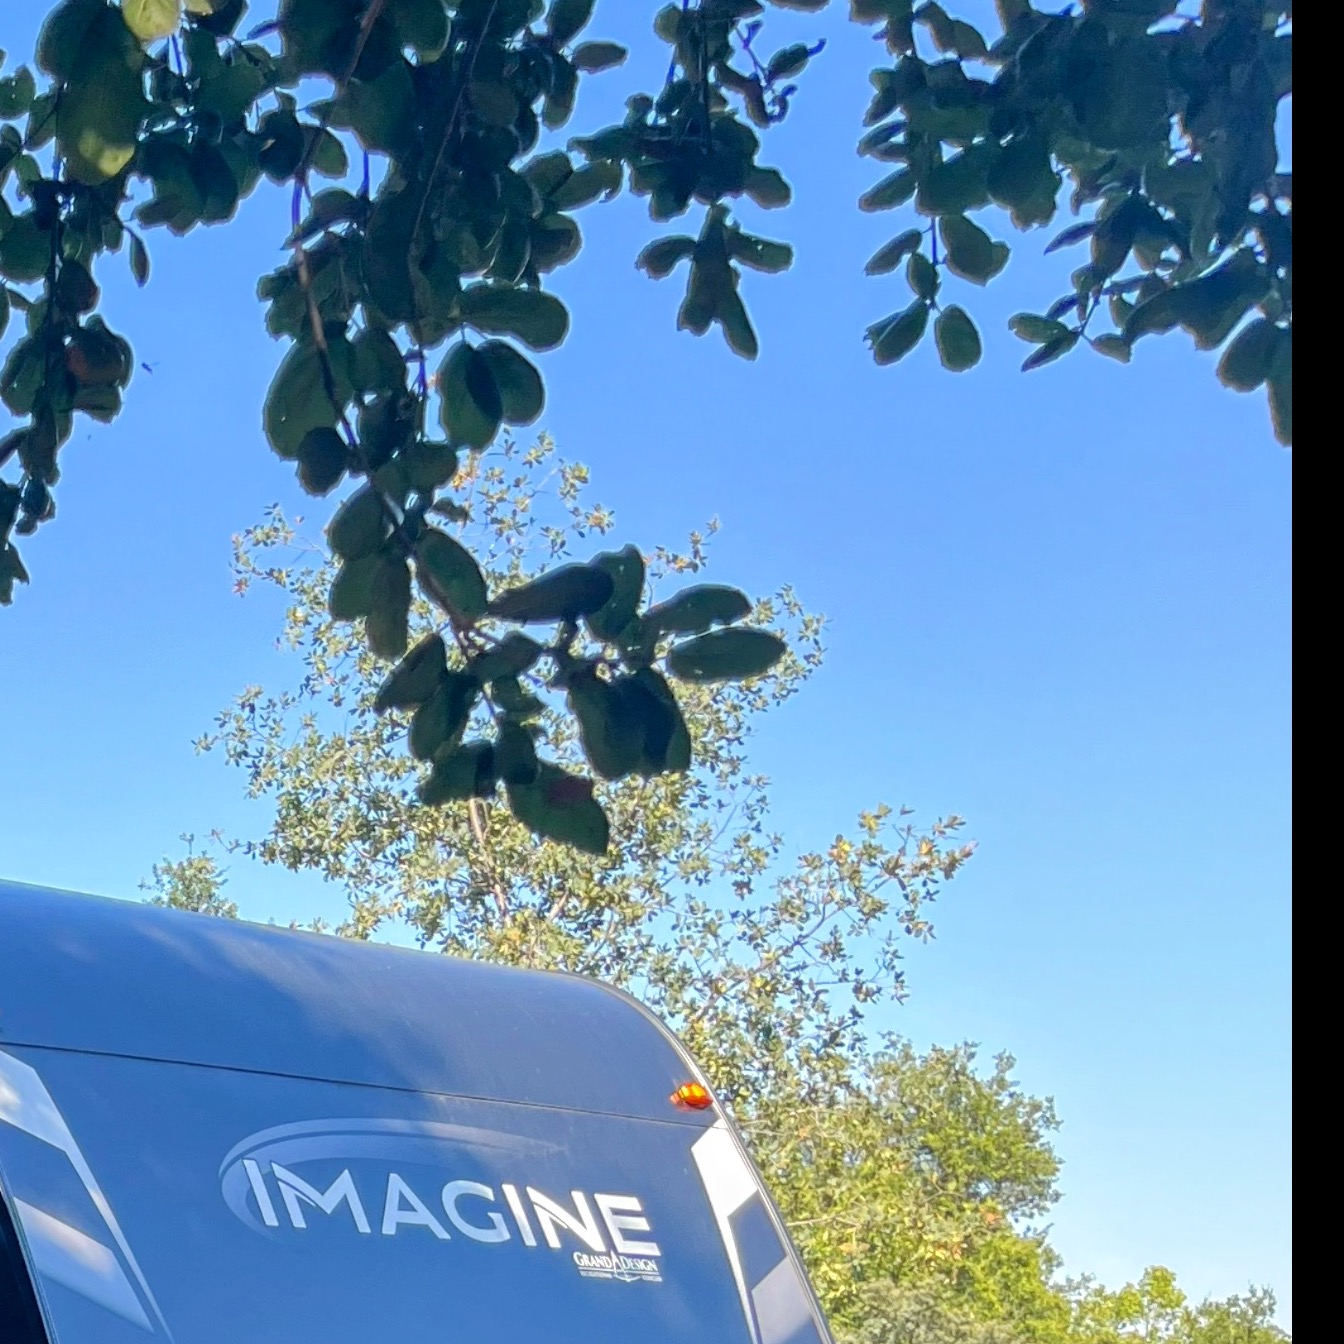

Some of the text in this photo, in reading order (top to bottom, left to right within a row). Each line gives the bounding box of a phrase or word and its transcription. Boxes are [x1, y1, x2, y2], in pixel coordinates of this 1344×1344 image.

[243, 1159, 660, 1256] IMAGINE
[573, 1252, 658, 1271] GRAND DESIGN
